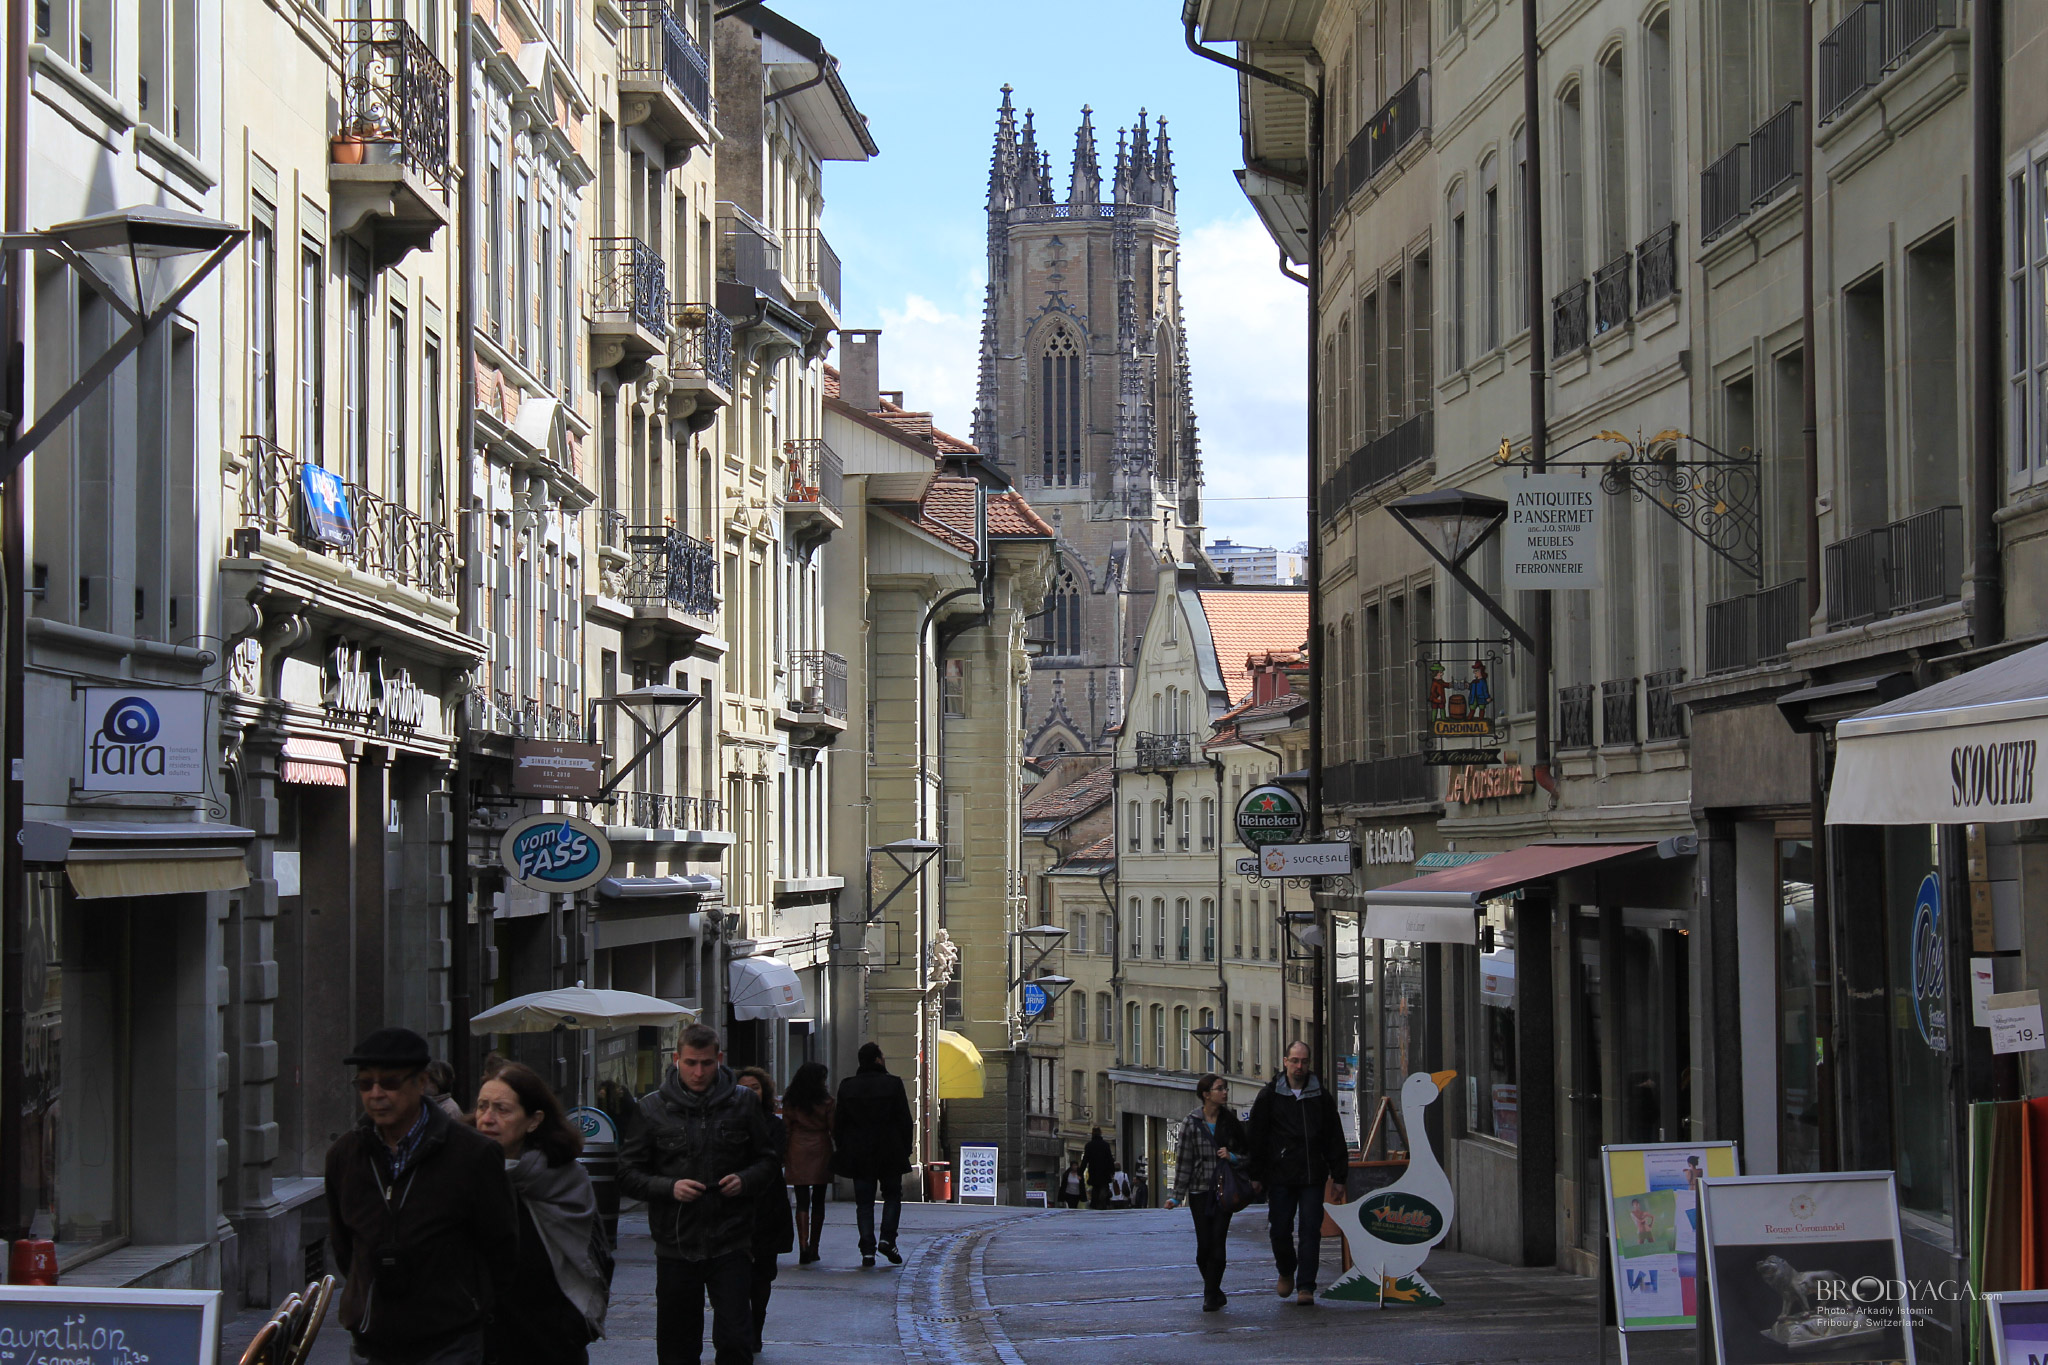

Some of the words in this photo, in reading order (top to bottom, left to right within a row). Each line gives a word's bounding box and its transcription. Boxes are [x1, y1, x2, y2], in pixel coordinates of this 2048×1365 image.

[1515, 491, 1593, 506] ANTIQUITES
[1558, 525, 1581, 533] STAUB
[1527, 536, 1574, 547] MEUBLES
[1532, 550, 1567, 560] ARMES
[1515, 563, 1584, 574] FERRONNERIE
[1436, 721, 1487, 733] CARDINAL
[88, 728, 166, 777] fara
[1951, 739, 2037, 808] SCOOTER
[1241, 814, 1298, 826] Heineken
[520, 829, 556, 853] vom
[519, 835, 588, 879] FASS
[1371, 1204, 1432, 1228] Valette
[1764, 1224, 1793, 1235] Rouge
[1795, 1222, 1846, 1233] Coromandel
